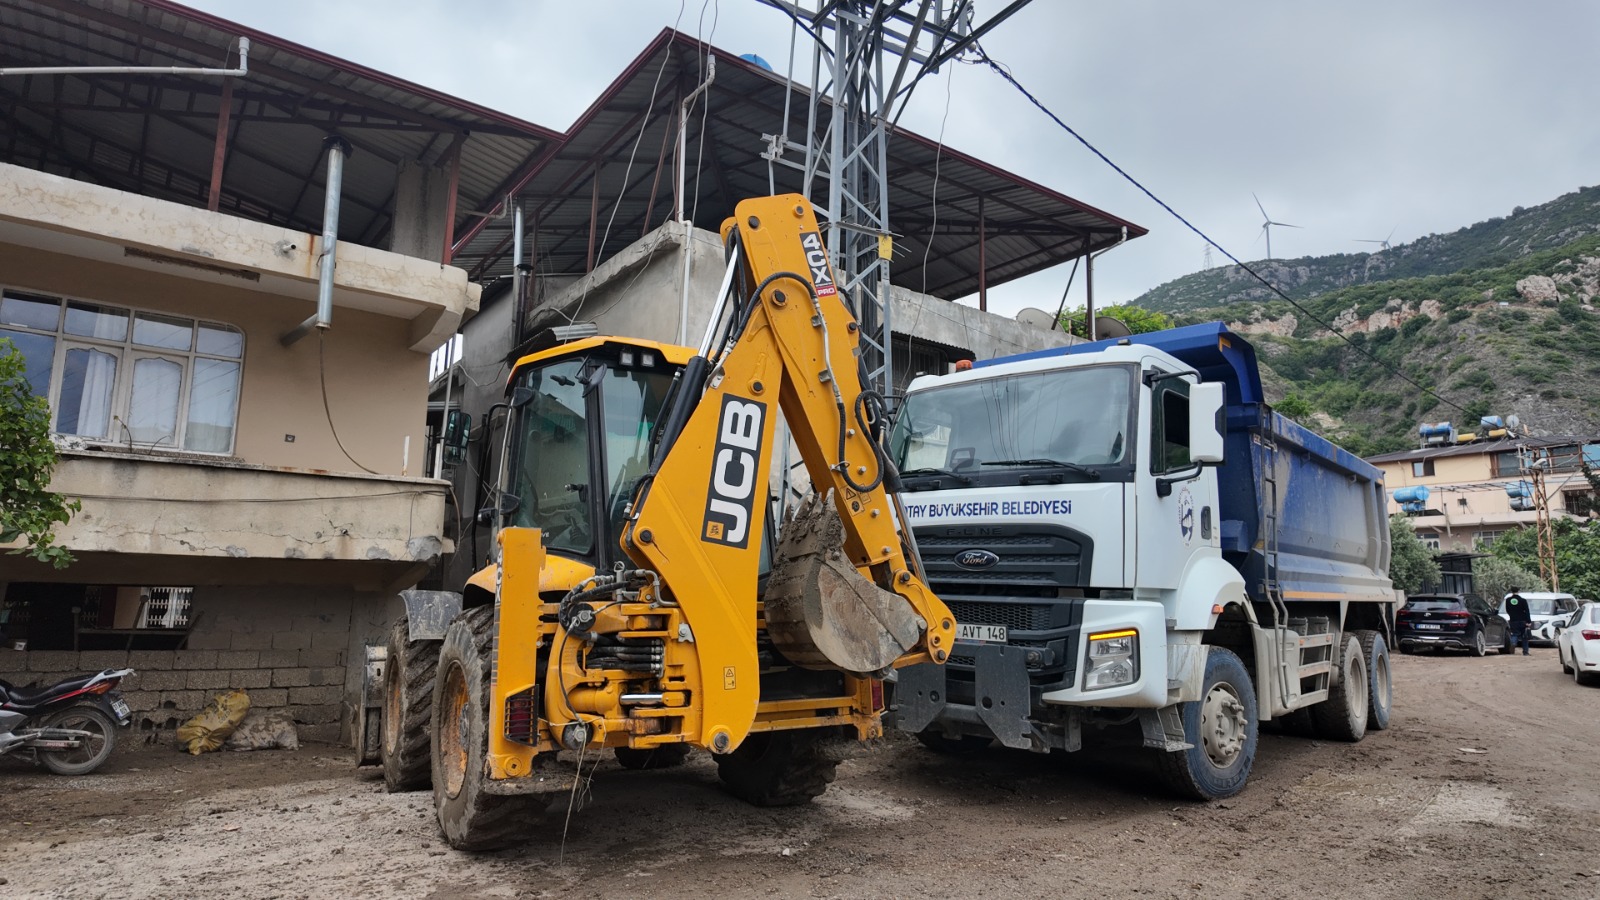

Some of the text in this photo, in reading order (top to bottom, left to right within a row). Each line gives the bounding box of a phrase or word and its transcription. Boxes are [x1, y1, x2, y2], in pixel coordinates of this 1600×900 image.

[803, 233, 832, 283] 4CX
[709, 400, 762, 543] JCB
[896, 505, 927, 518] TAY
[962, 552, 988, 565] Ford
[962, 625, 1005, 640] AVT 148
